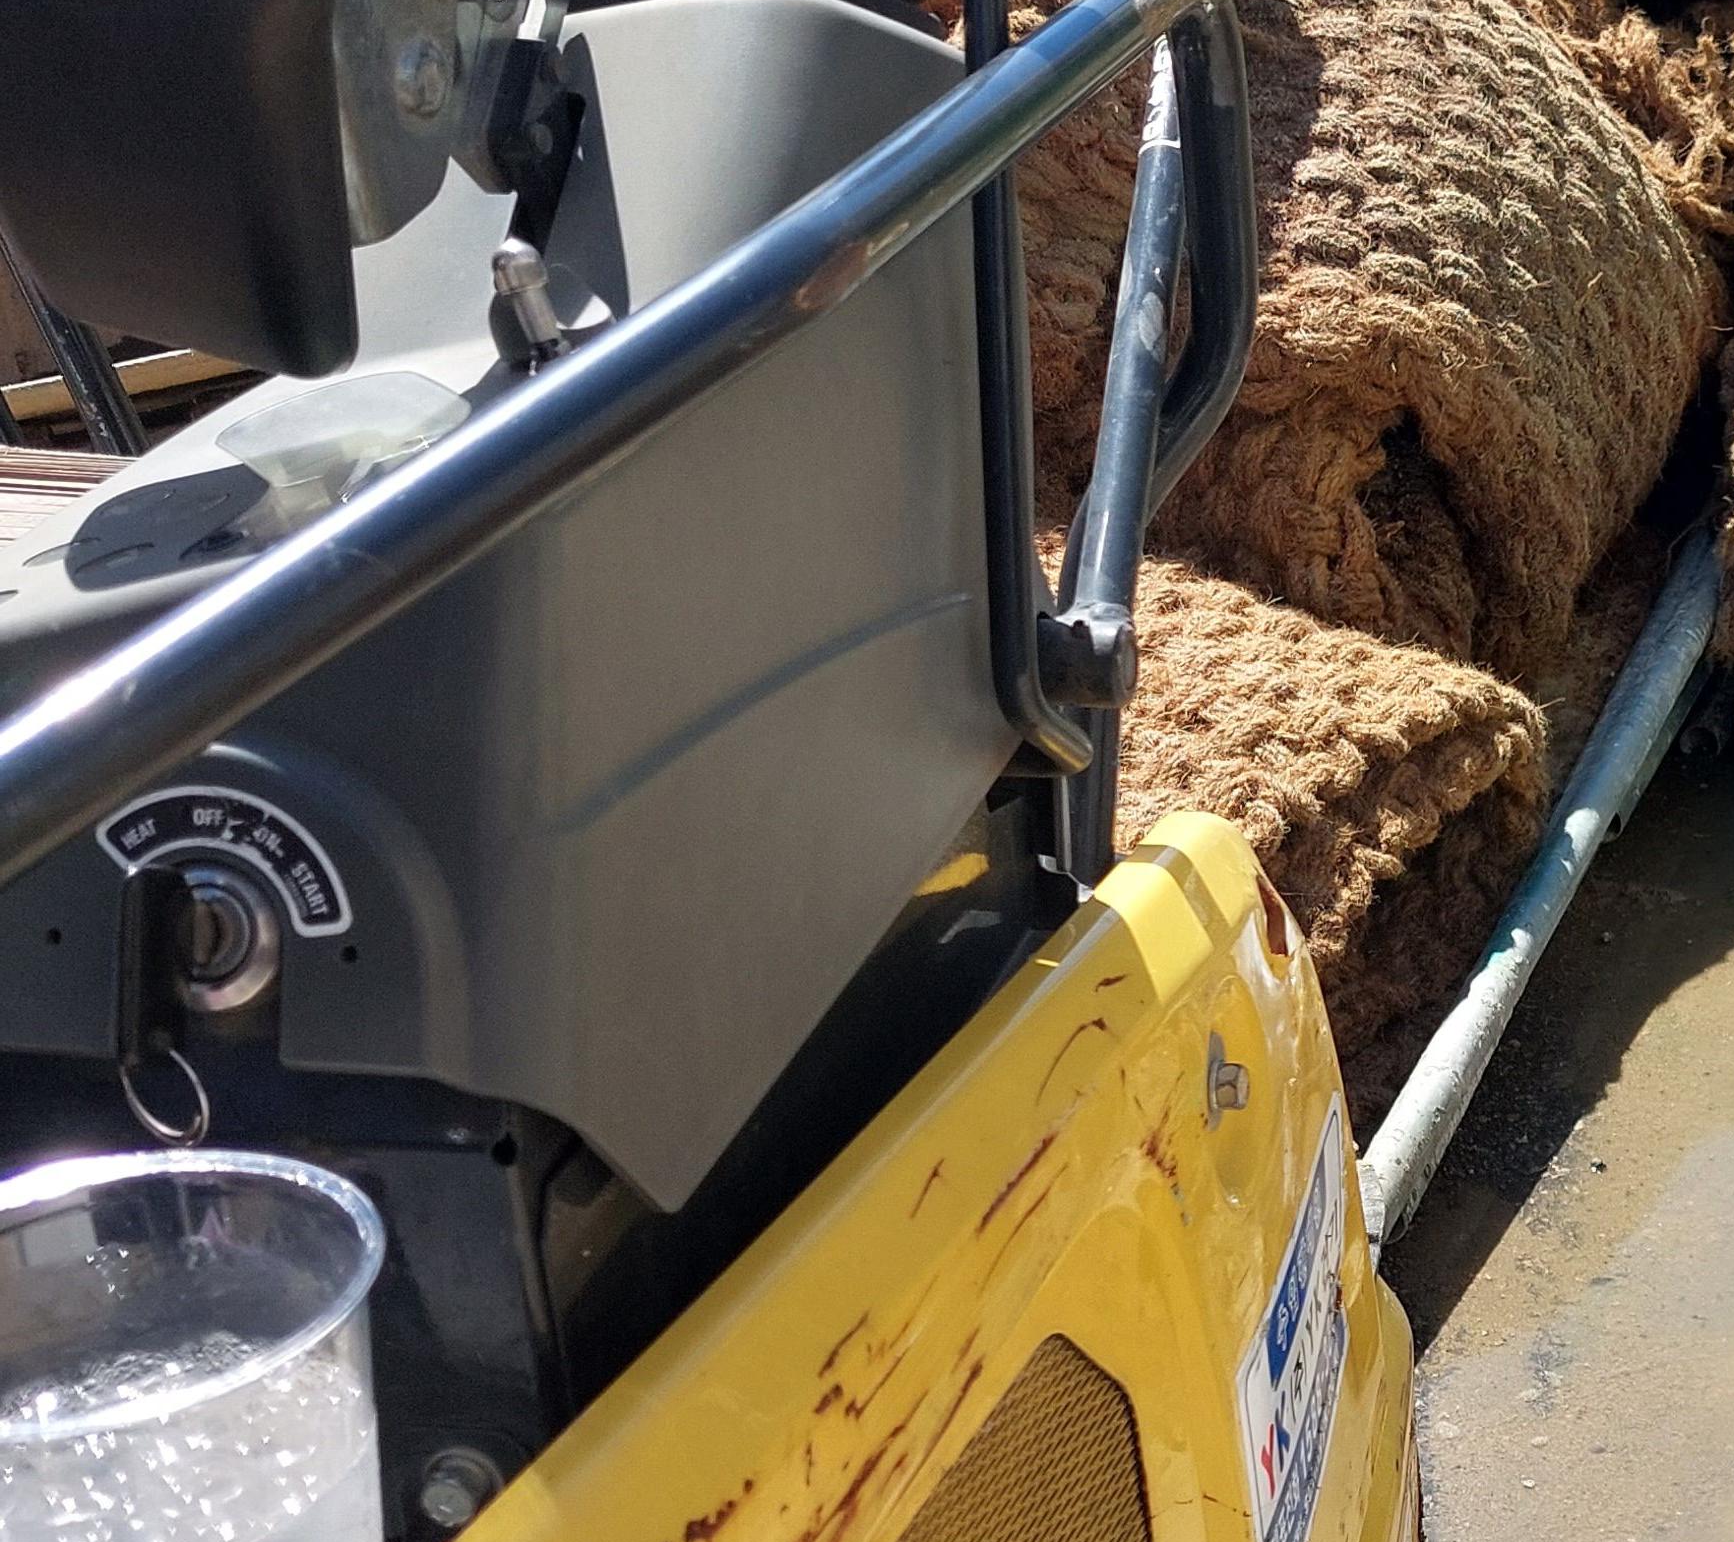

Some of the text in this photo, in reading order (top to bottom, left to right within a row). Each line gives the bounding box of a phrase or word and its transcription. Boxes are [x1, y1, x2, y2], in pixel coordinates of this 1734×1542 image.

[193, 808, 224, 827] OFF
[292, 862, 328, 914] START
[1261, 1390, 1290, 1499] YK
